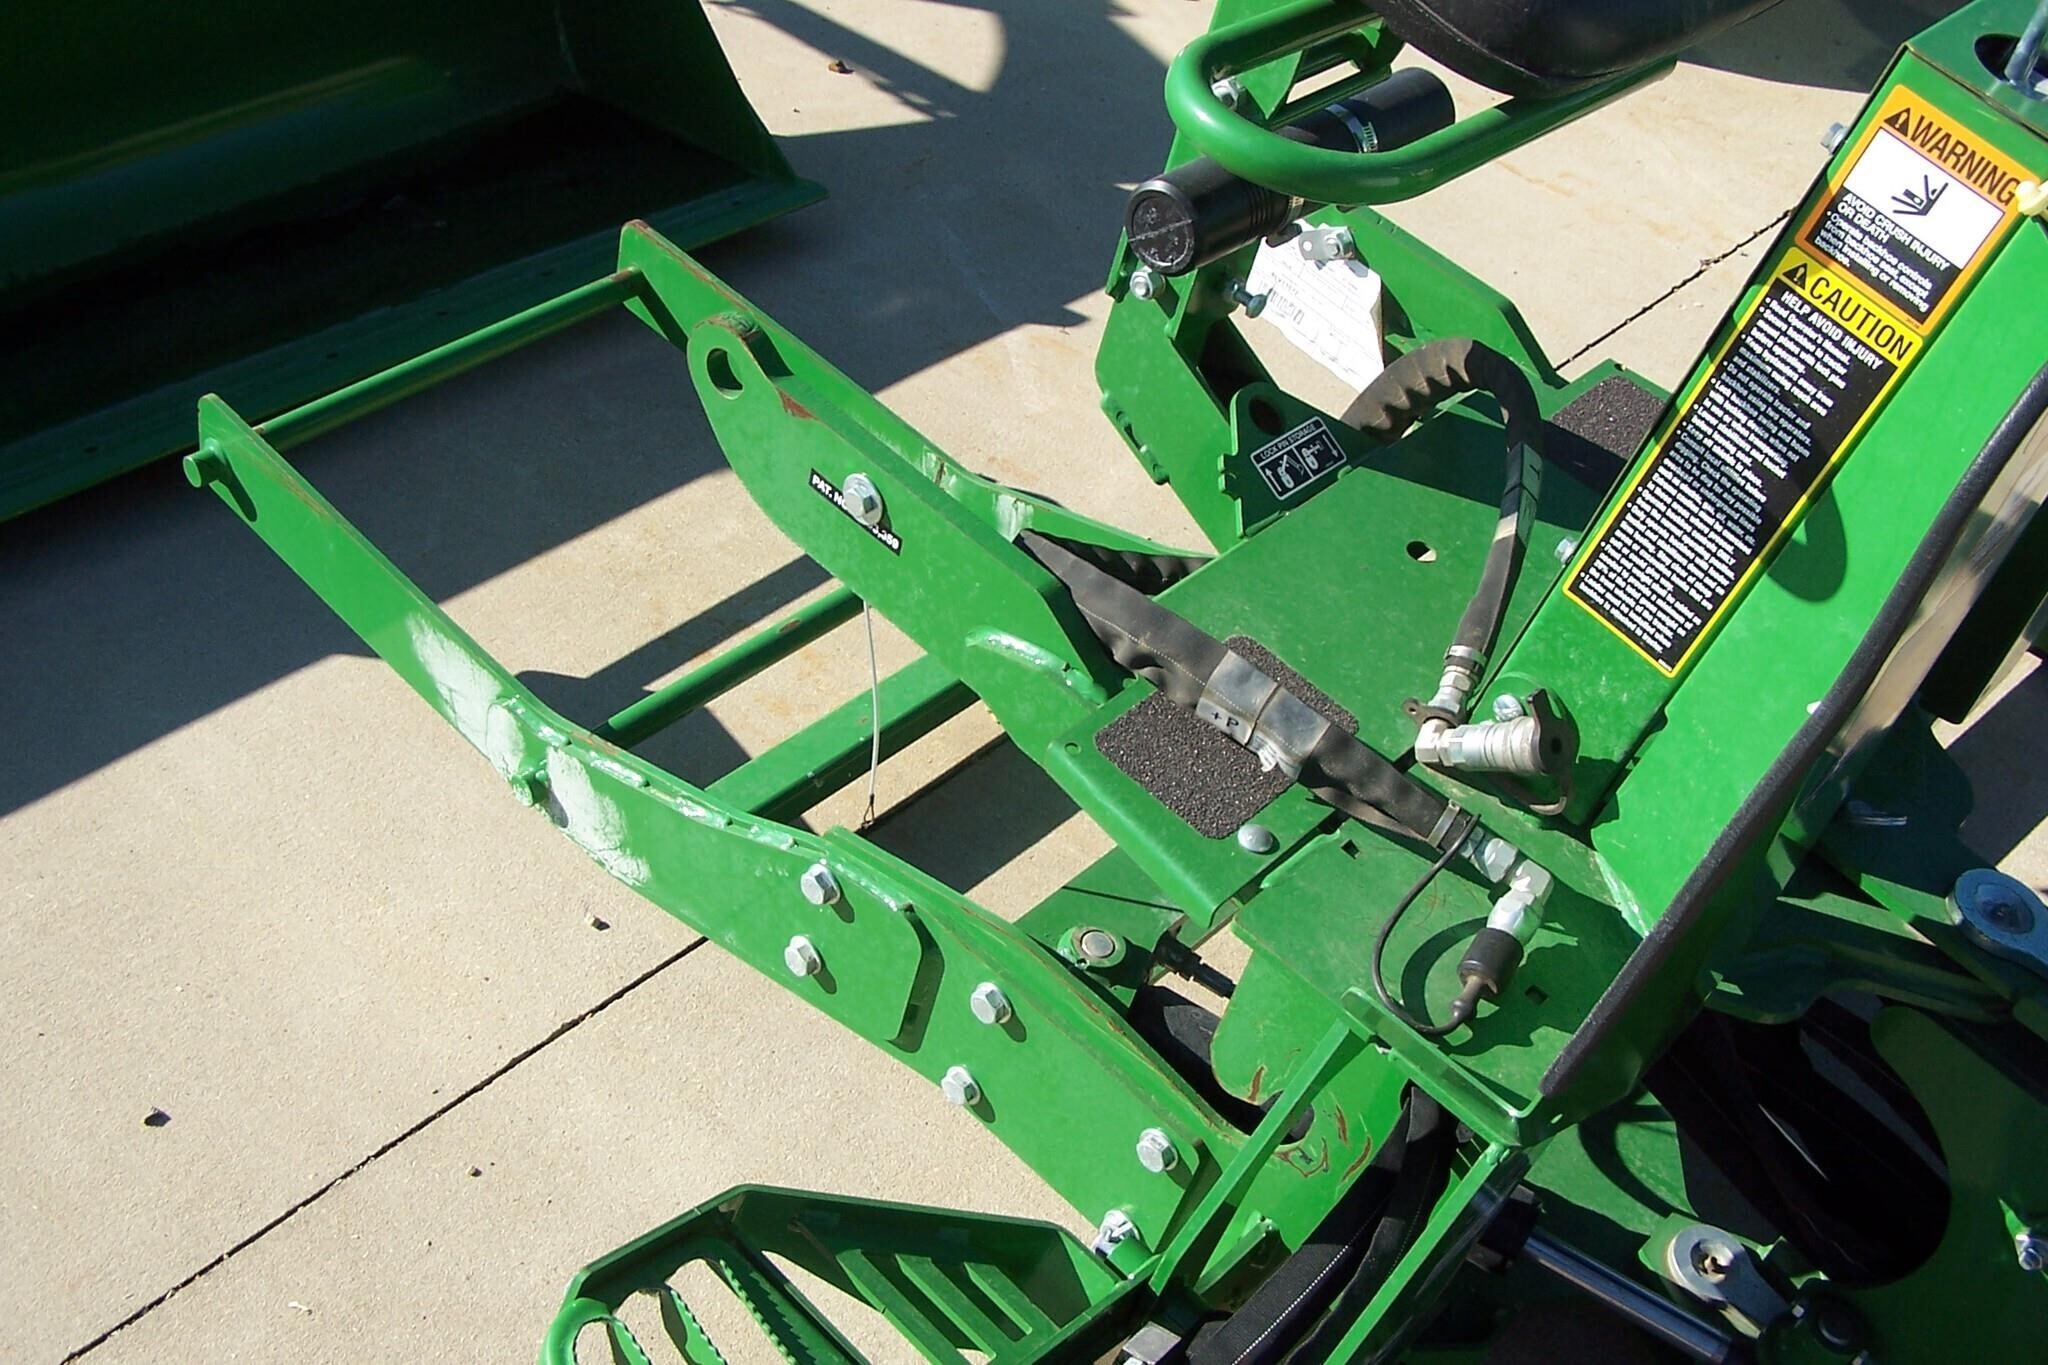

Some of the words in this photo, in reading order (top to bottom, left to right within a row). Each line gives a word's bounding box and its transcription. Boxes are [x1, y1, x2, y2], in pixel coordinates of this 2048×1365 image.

[1909, 115, 2020, 206] WARNING
[1838, 202, 1856, 219] OR
[1853, 213, 1890, 243] DEATH
[1842, 193, 1876, 219] AVOID
[1874, 214, 1913, 246] CRUSH
[1910, 239, 1950, 271] INJURY
[1781, 291, 1811, 315] HELP
[1808, 312, 1843, 341] AVOID
[1841, 335, 1883, 370] INJURY
[1810, 277, 1913, 361] CAUTION
[1260, 446, 1278, 459] LOCK
[1277, 440, 1289, 449] PIN
[1288, 424, 1315, 443] STORAGE
[812, 474, 832, 498] PAT.
